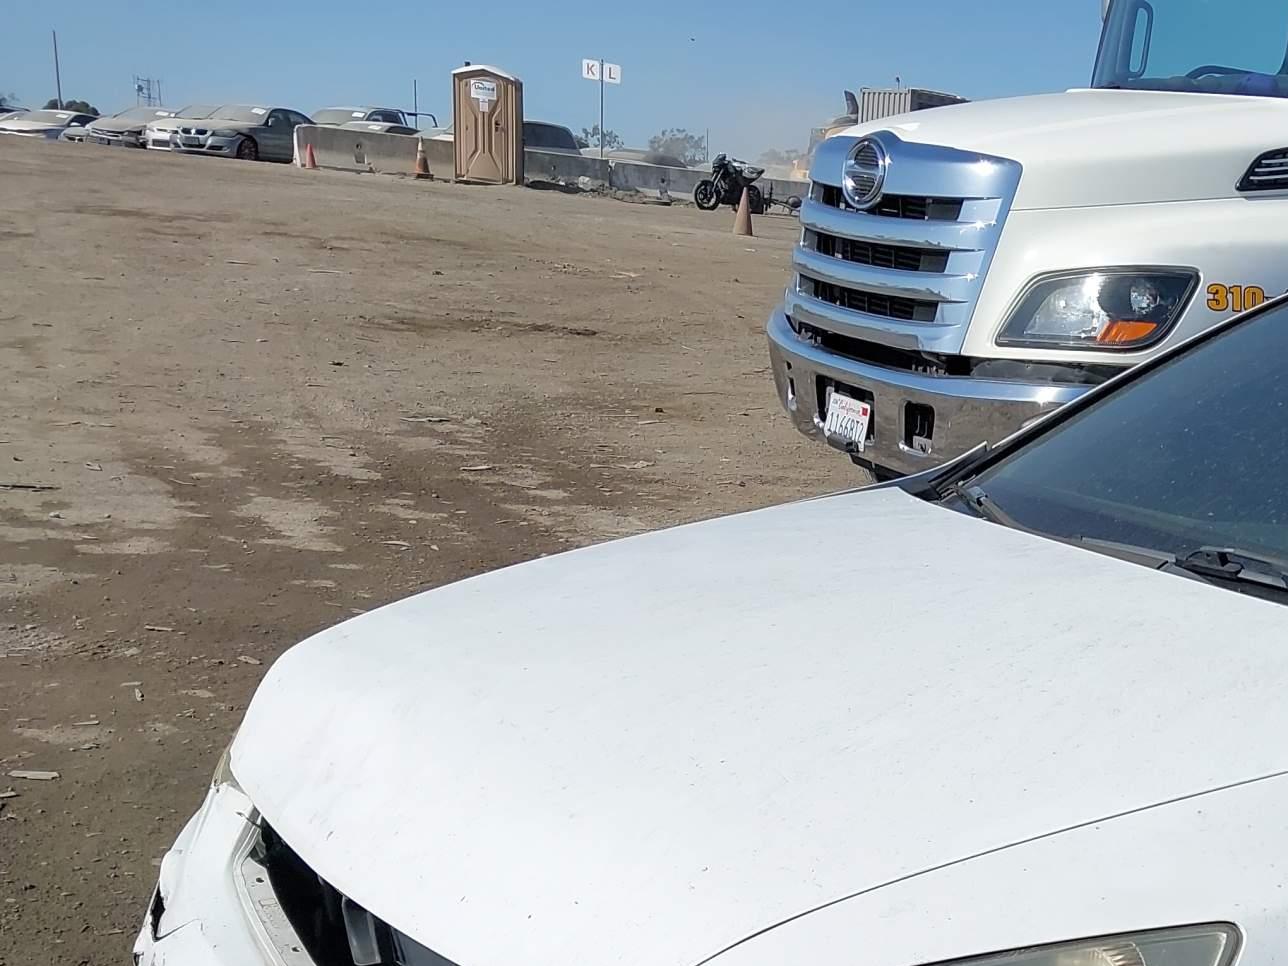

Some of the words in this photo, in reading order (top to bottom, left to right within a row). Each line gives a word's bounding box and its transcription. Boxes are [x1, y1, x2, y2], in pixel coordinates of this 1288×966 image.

[586, 62, 595, 76] K
[608, 67, 616, 80] L
[1207, 283, 1265, 312] 310
